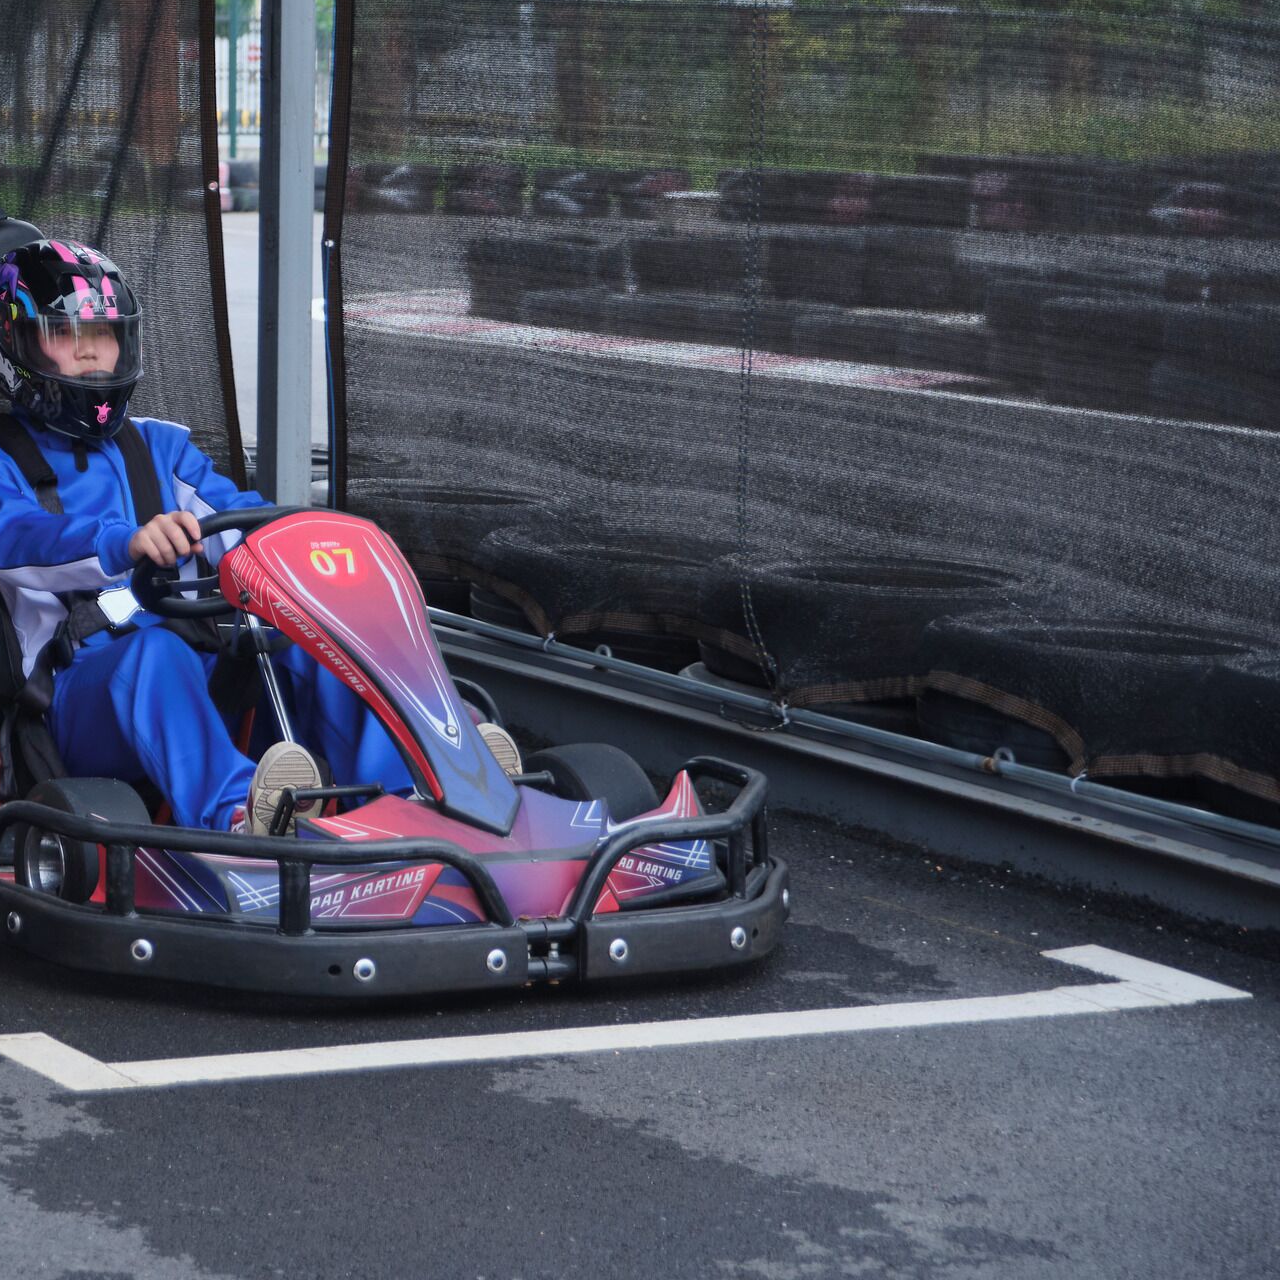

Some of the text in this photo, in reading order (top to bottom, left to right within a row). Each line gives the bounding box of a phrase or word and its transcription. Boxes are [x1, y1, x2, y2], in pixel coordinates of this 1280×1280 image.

[309, 547, 355, 576] 07
[316, 642, 367, 692] KARTING
[351, 868, 427, 900] KARTING
[636, 860, 683, 880] KARTING
